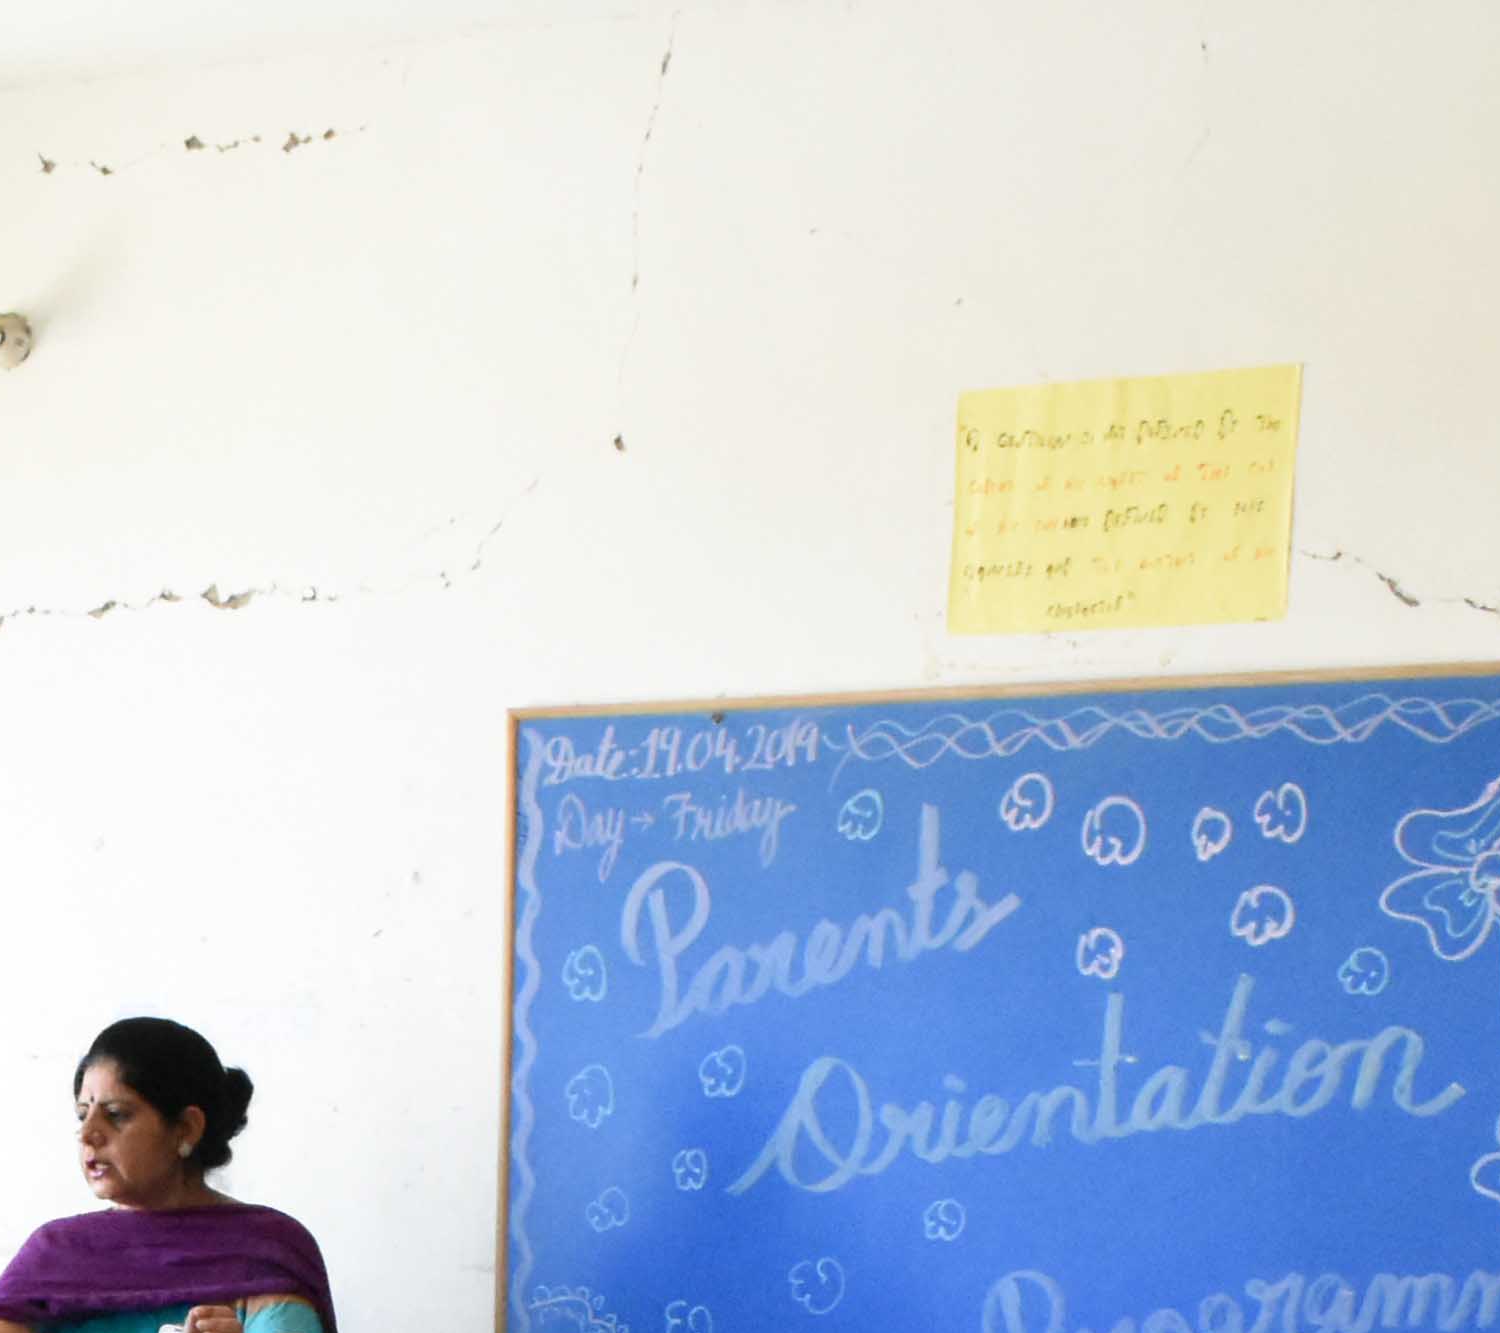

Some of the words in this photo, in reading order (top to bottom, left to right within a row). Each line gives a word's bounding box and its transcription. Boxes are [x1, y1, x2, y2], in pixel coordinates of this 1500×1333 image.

[554, 791, 625, 884] Day
[662, 785, 797, 868] Friday
[619, 802, 1022, 1038] Parents
[724, 973, 1467, 1193] Orientation
